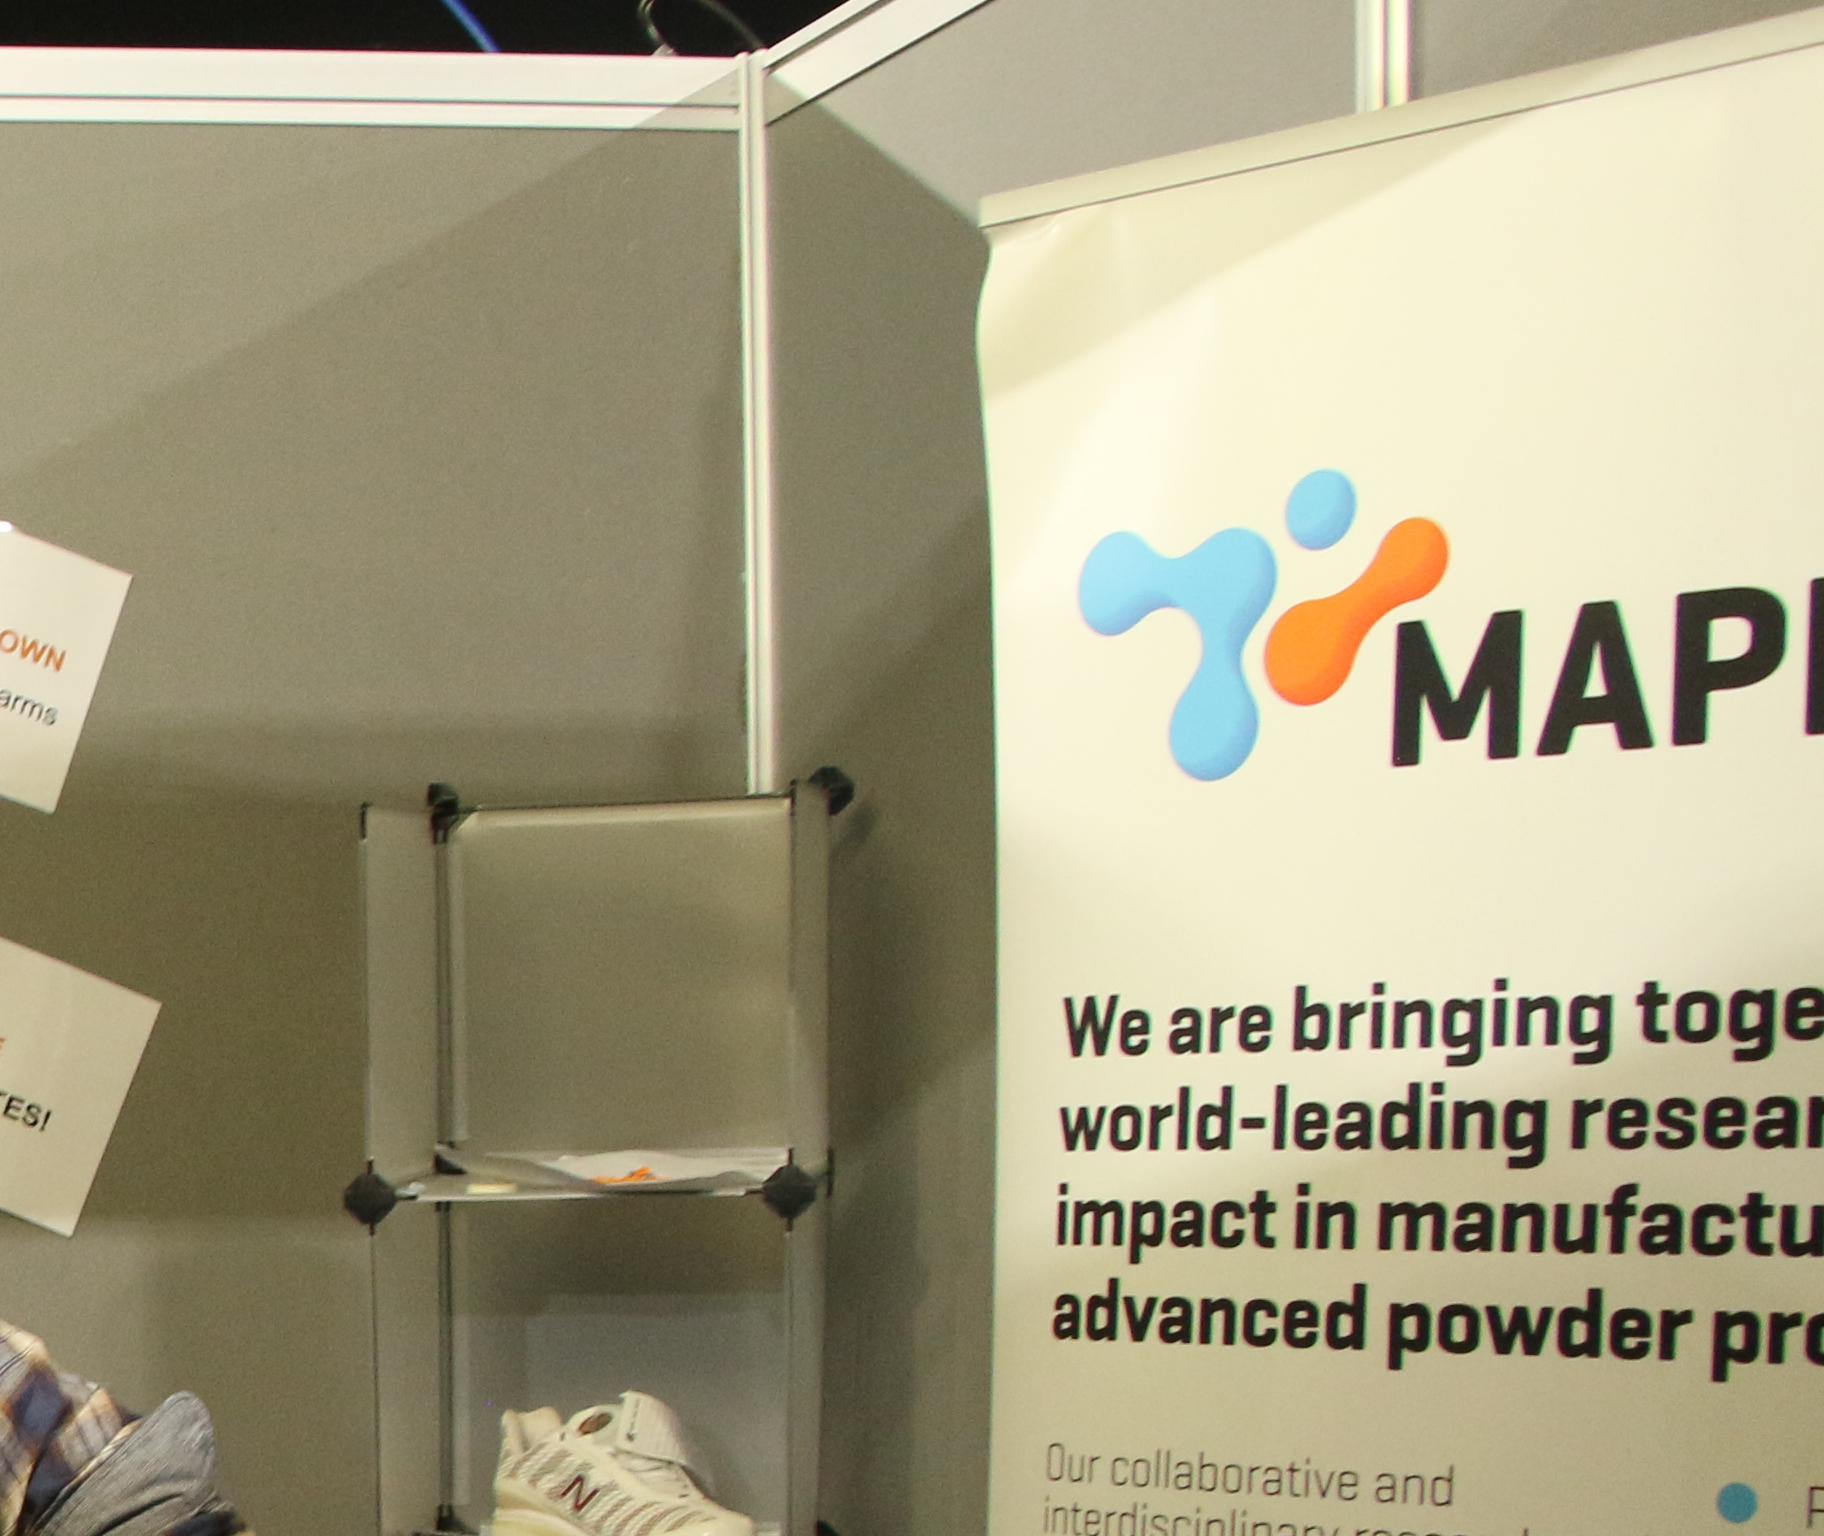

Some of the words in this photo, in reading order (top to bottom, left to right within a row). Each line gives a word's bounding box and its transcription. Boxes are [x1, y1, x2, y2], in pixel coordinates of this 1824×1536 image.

[1390, 577, 1824, 768] MAP
[1064, 992, 1150, 1057] We
[1167, 1002, 1272, 1055] are
[1292, 978, 1615, 1067] bringing
[1637, 981, 1824, 1063] toge
[1060, 1080, 1548, 1169] world-leading
[1056, 1183, 1277, 1264] impact
[1294, 1183, 1354, 1250] in
[1377, 1183, 1824, 1257] manufactu
[1054, 1277, 1367, 1351] advanced
[1387, 1288, 1693, 1371] powder
[1046, 1442, 1100, 1485] Our
[1110, 1450, 1359, 1502] collaborative
[1374, 1464, 1455, 1508] and
